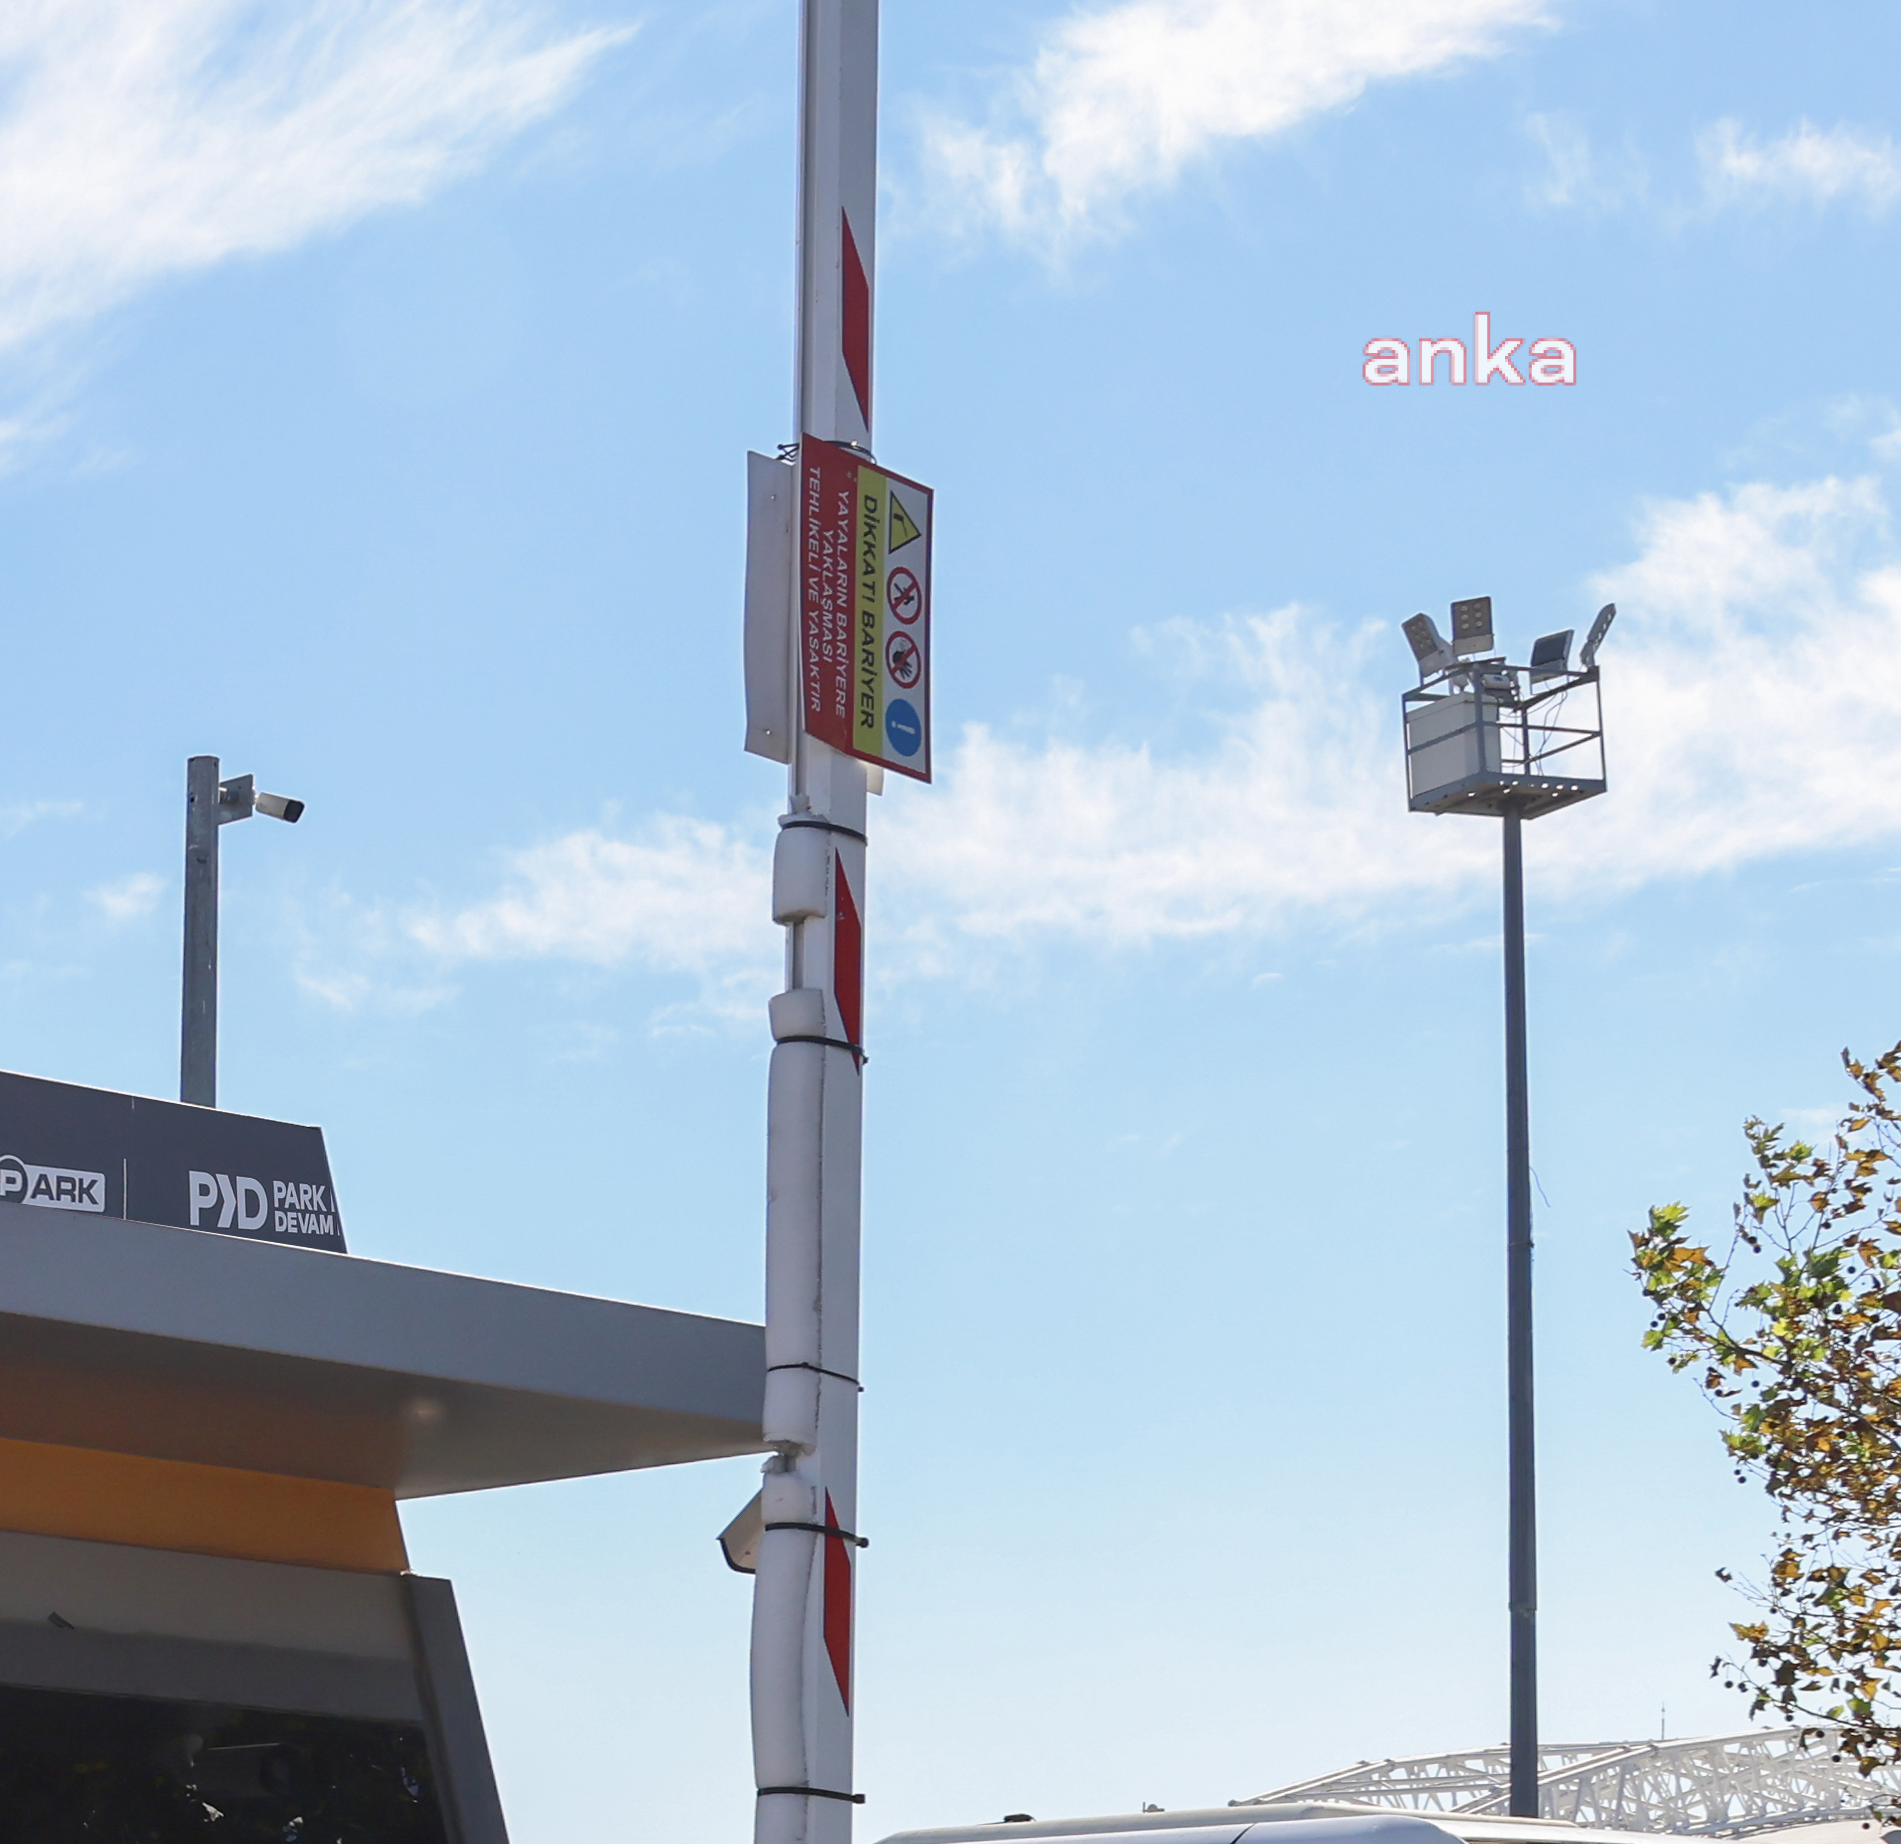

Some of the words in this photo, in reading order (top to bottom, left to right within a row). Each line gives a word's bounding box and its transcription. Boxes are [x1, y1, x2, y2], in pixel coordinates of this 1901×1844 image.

[808, 466, 821, 572] TEHLİKELİ
[836, 490, 850, 607] YAYALARIN
[808, 577, 819, 603] VE
[821, 530, 834, 663] YAKLAŞMASI
[809, 610, 821, 712] YASAKTIR
[835, 612, 847, 718] BARİYERE
[860, 610, 876, 729] BARİYER
[273, 1180, 327, 1212] PARK
[274, 1213, 334, 1236] DEVAM
